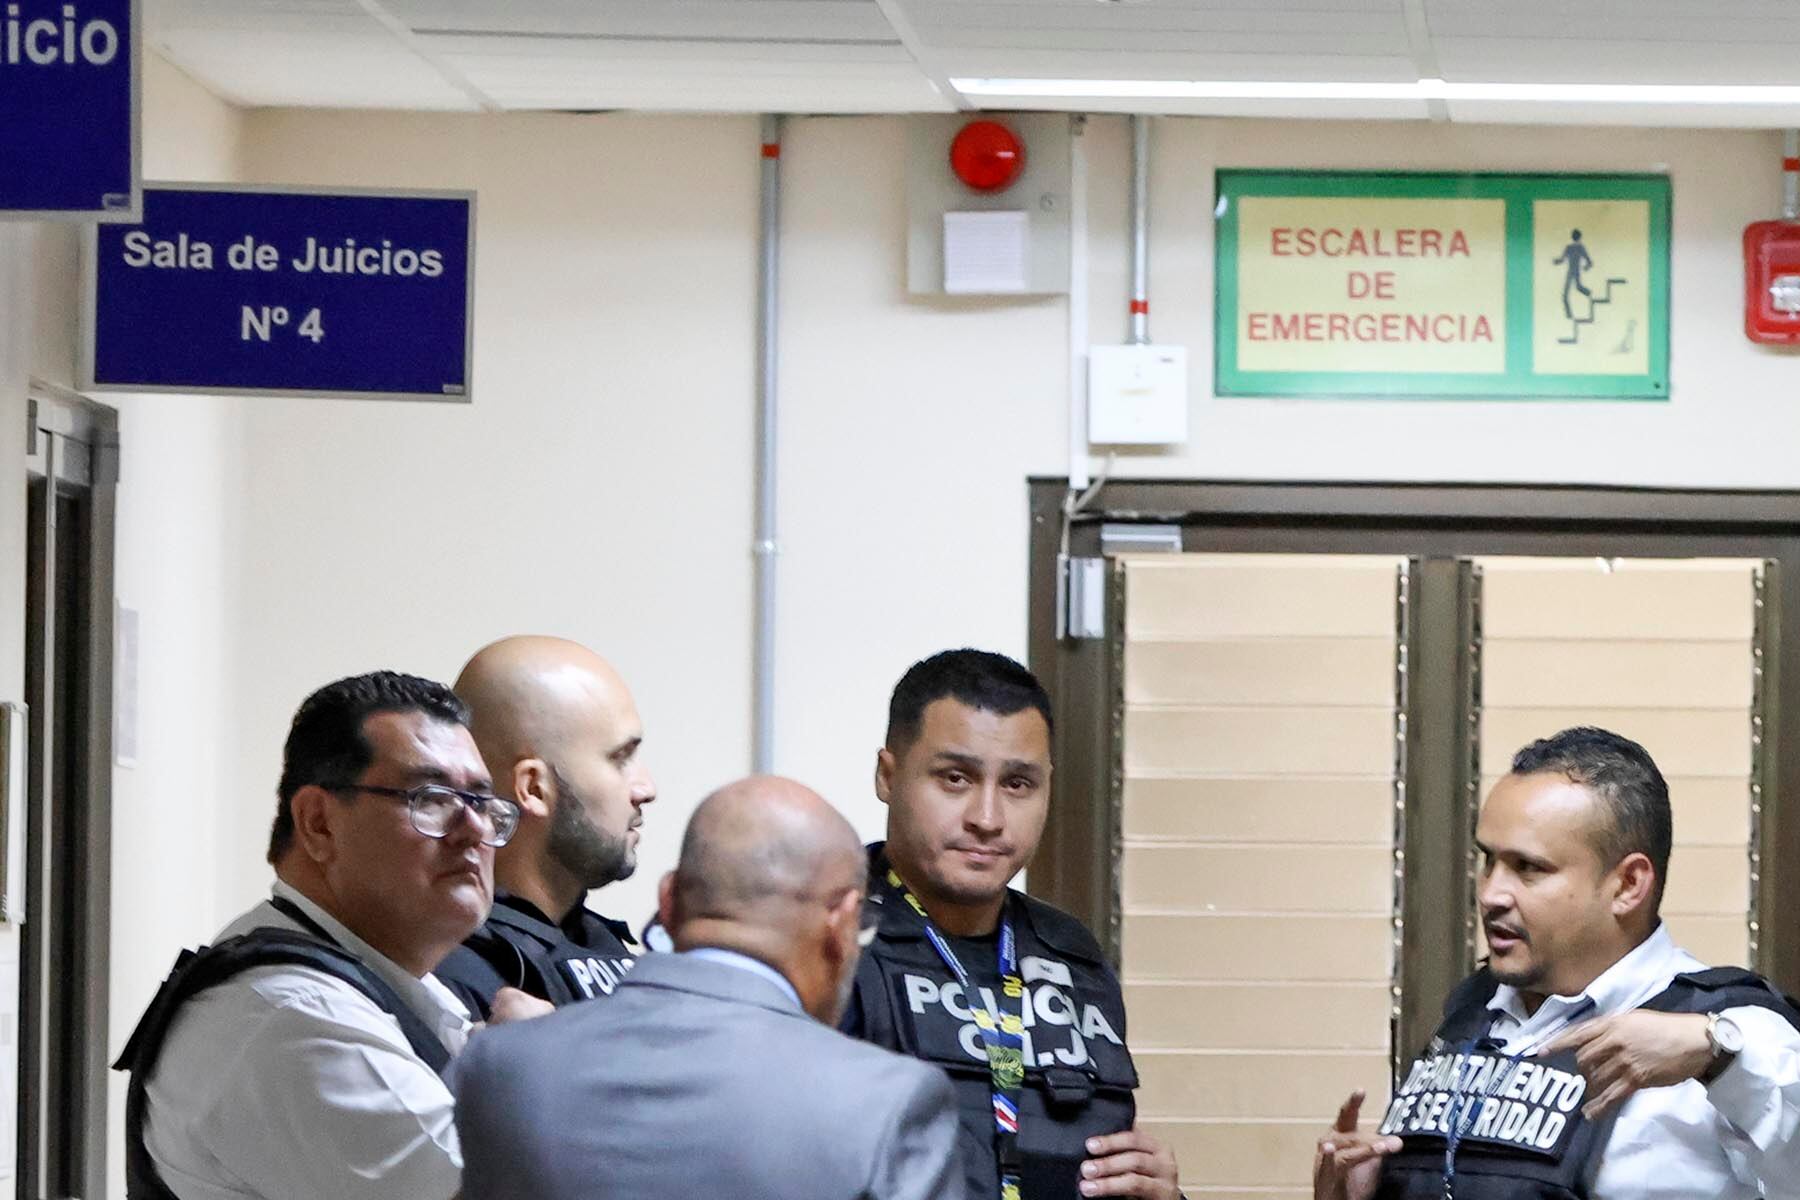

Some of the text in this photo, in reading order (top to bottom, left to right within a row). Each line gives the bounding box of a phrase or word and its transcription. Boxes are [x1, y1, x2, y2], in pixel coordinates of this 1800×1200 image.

[0, 3, 118, 65] icio
[122, 230, 445, 278] Sala de Juicios
[1269, 226, 1472, 258] ESCALERA
[1346, 271, 1396, 300] DE
[297, 306, 326, 343] 4
[1246, 312, 1495, 343] EMERGENCIA
